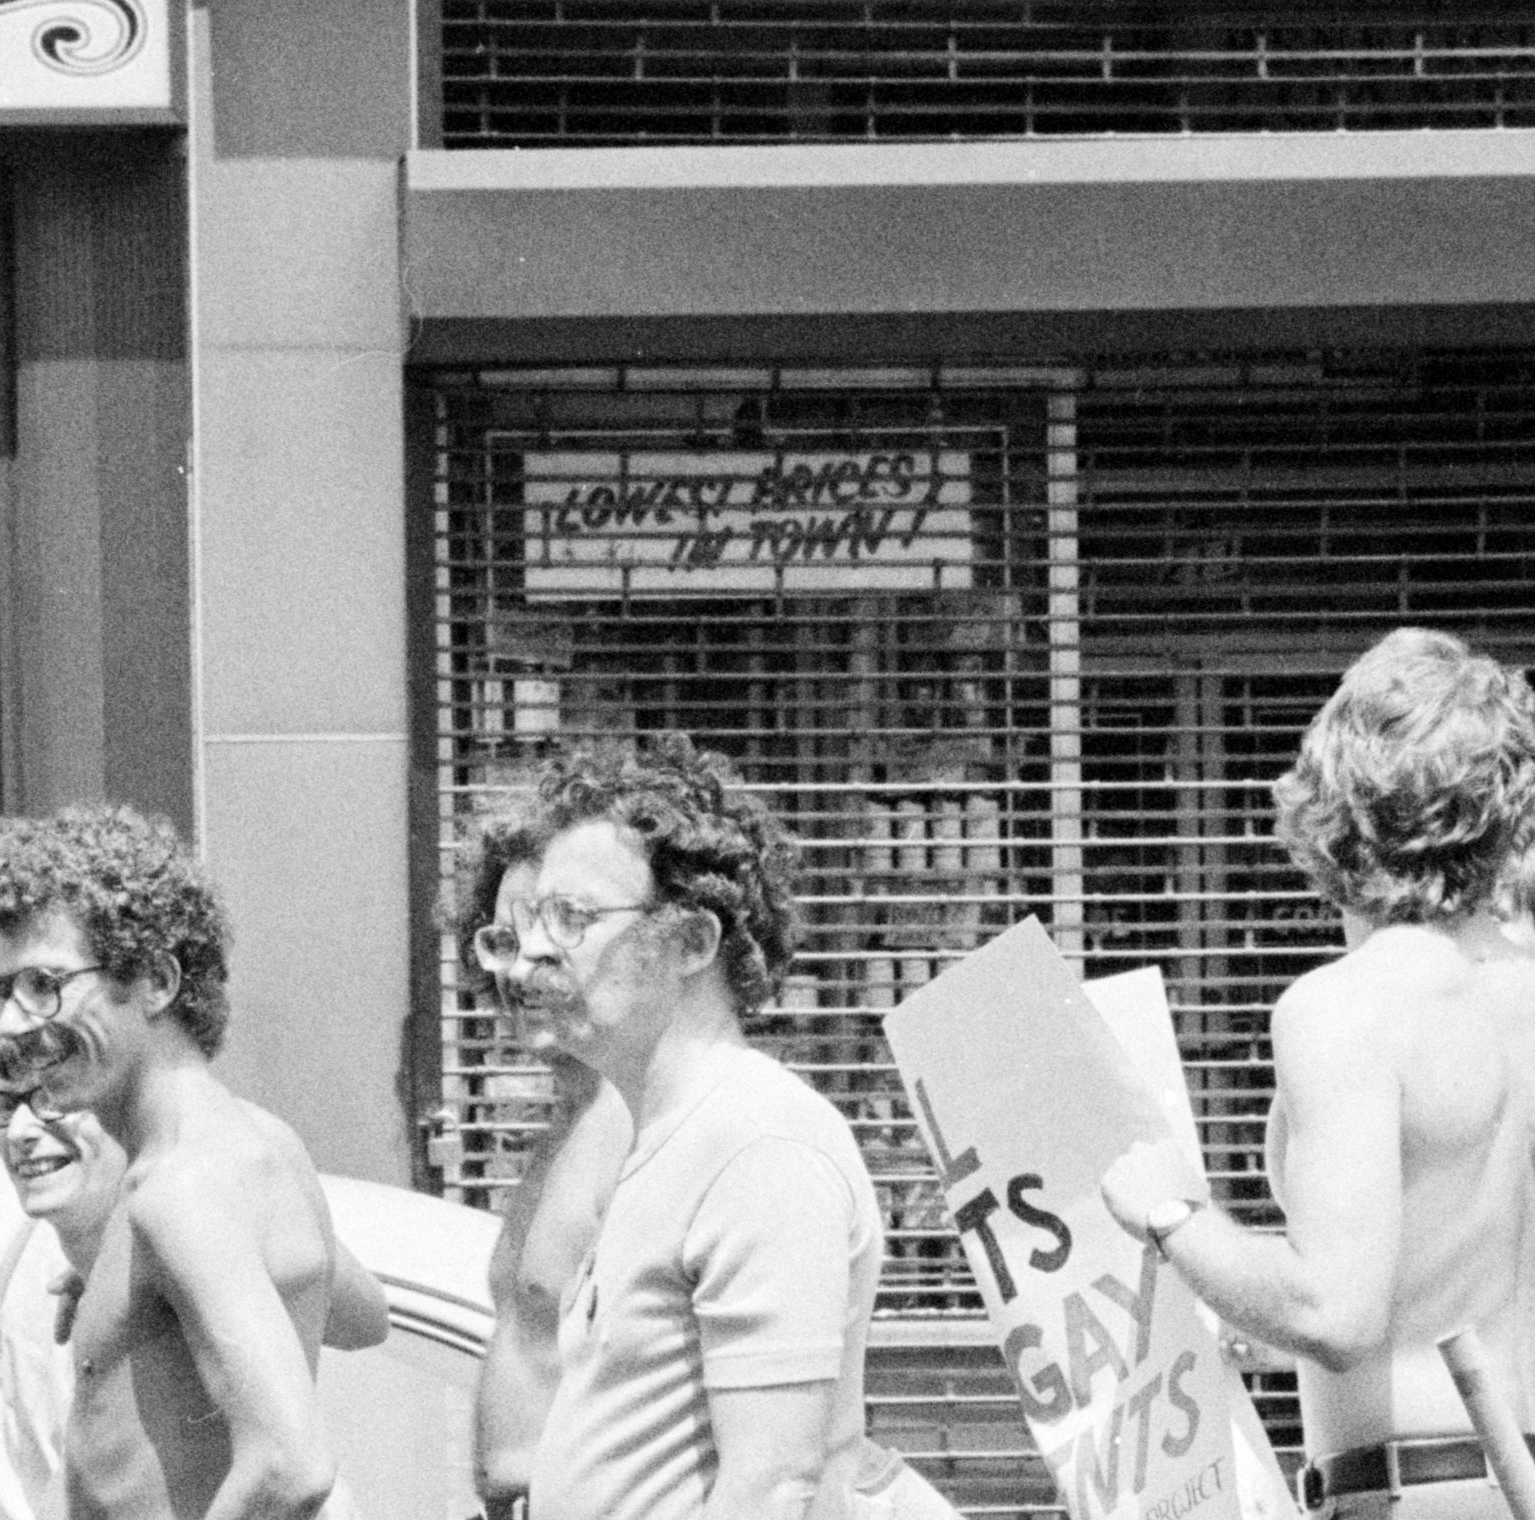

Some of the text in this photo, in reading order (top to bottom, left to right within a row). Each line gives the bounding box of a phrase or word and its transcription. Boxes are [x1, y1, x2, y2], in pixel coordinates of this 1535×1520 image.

[555, 455, 916, 530] LOWEST PRICES
[954, 1173, 1073, 1305] TS
[1004, 1246, 1159, 1425] GAY
